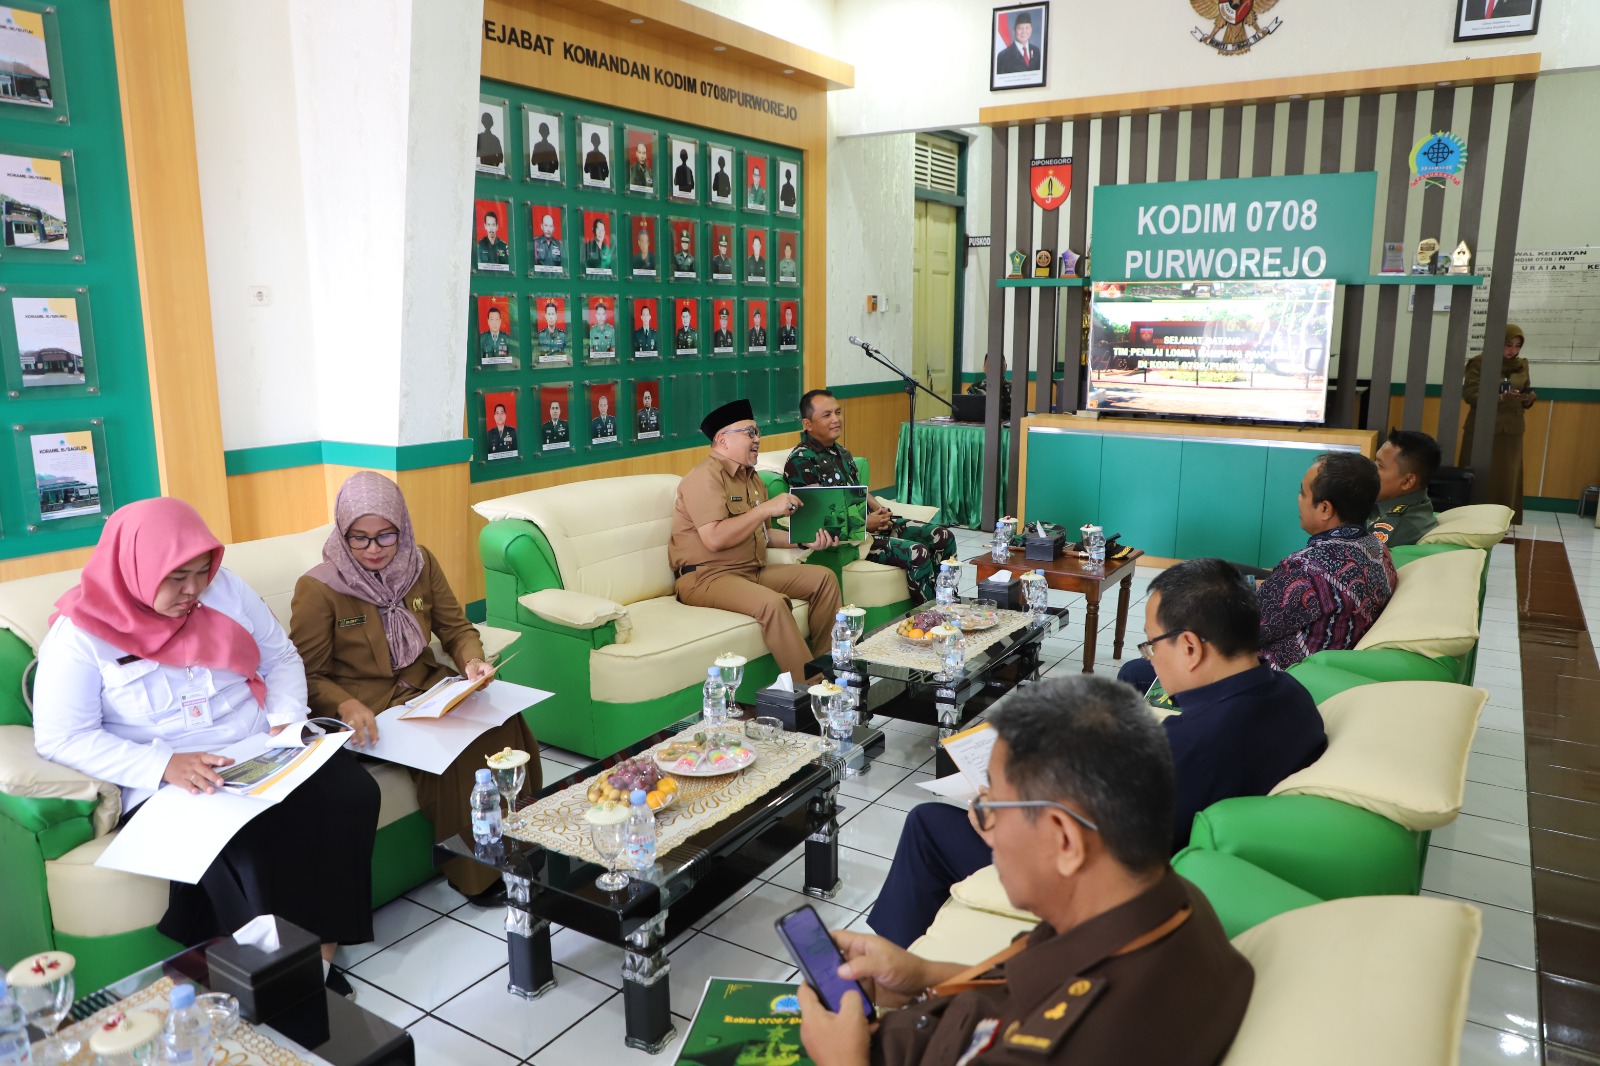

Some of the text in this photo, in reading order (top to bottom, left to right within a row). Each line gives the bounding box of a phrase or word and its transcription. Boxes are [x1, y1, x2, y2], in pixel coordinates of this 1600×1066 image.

[482, 19, 797, 121] EJABAT KOMANDAN KODIM 0708/PURWOREJO
[1031, 157, 1072, 166] DIPONEGORO
[1137, 199, 1318, 235] KODIM 0708
[1125, 246, 1327, 279] PURWOREJO
[1163, 335, 1203, 345] SELAMAT
[1113, 347, 1129, 356] TIM
[1130, 347, 1163, 357] PENILAI
[1165, 348, 1196, 358] LOMBA
[1137, 360, 1148, 369] DI
